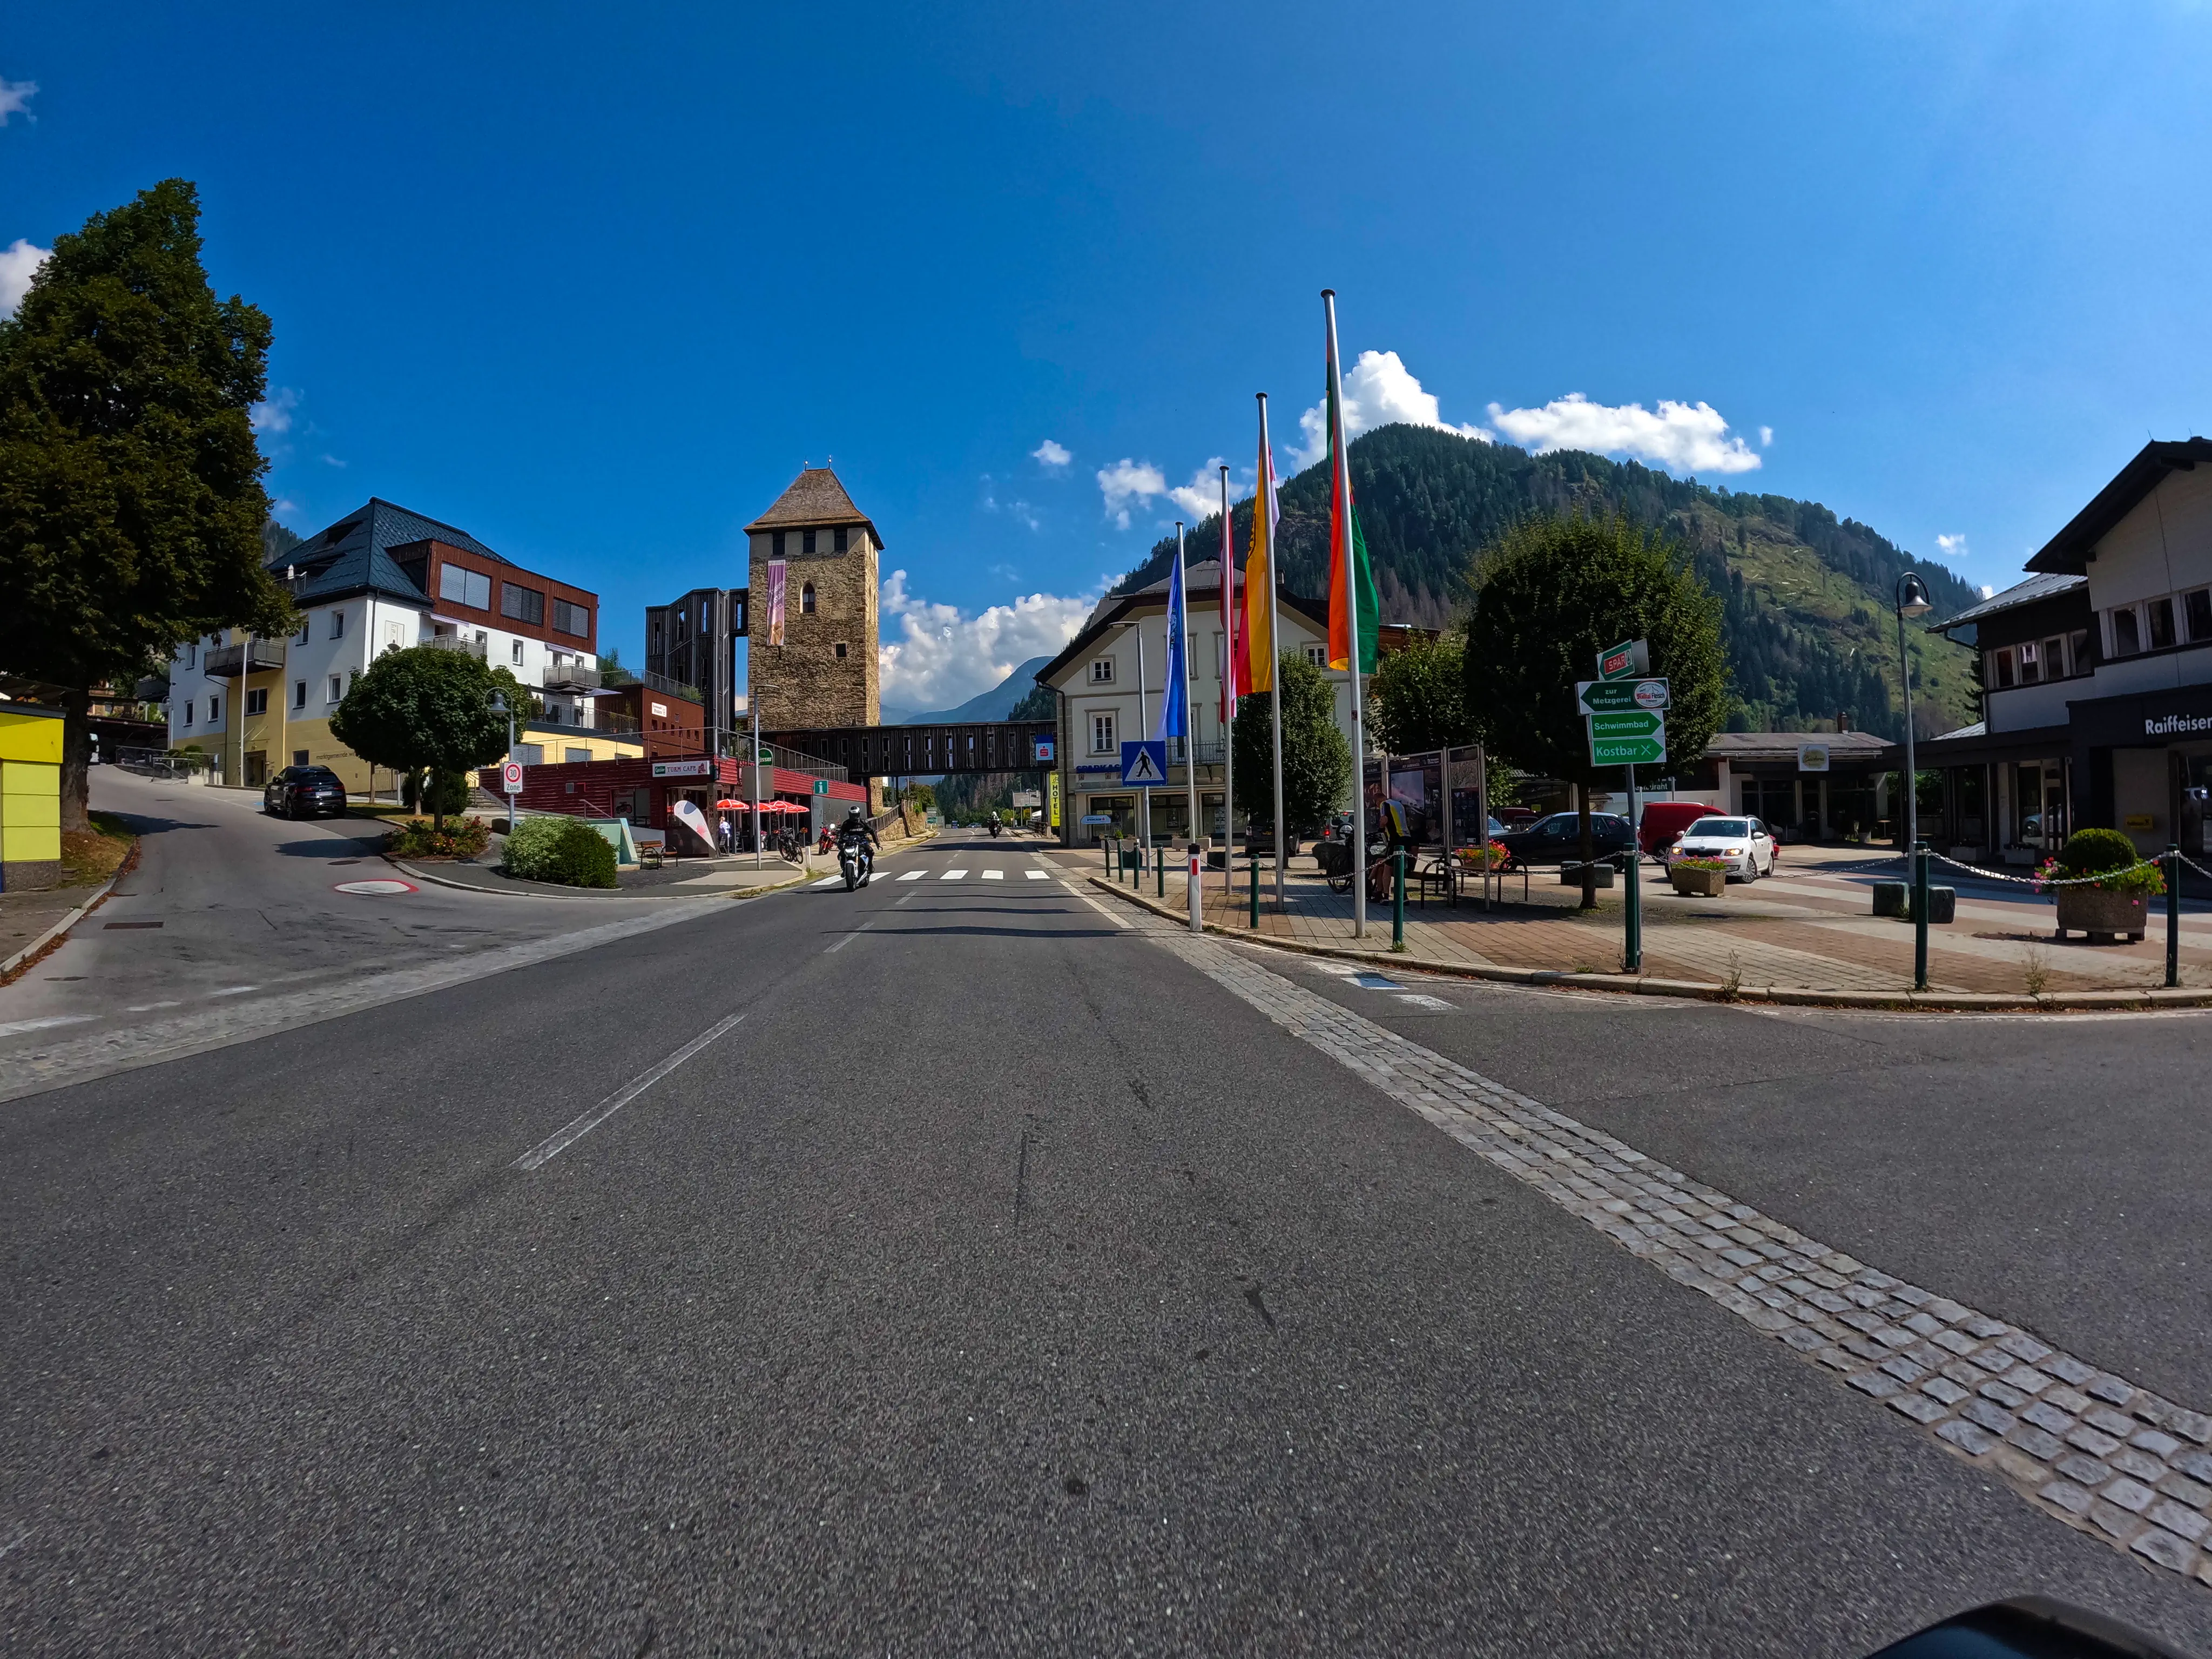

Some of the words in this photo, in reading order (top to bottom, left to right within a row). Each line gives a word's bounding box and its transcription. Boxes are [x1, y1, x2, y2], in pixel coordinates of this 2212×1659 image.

[1608, 656, 1626, 670] SPAR
[1593, 696, 1631, 705] Metzgerei
[1594, 720, 1649, 730] Schwimmbad
[1596, 745, 1637, 756] Kostbar
[509, 769, 517, 778] 30
